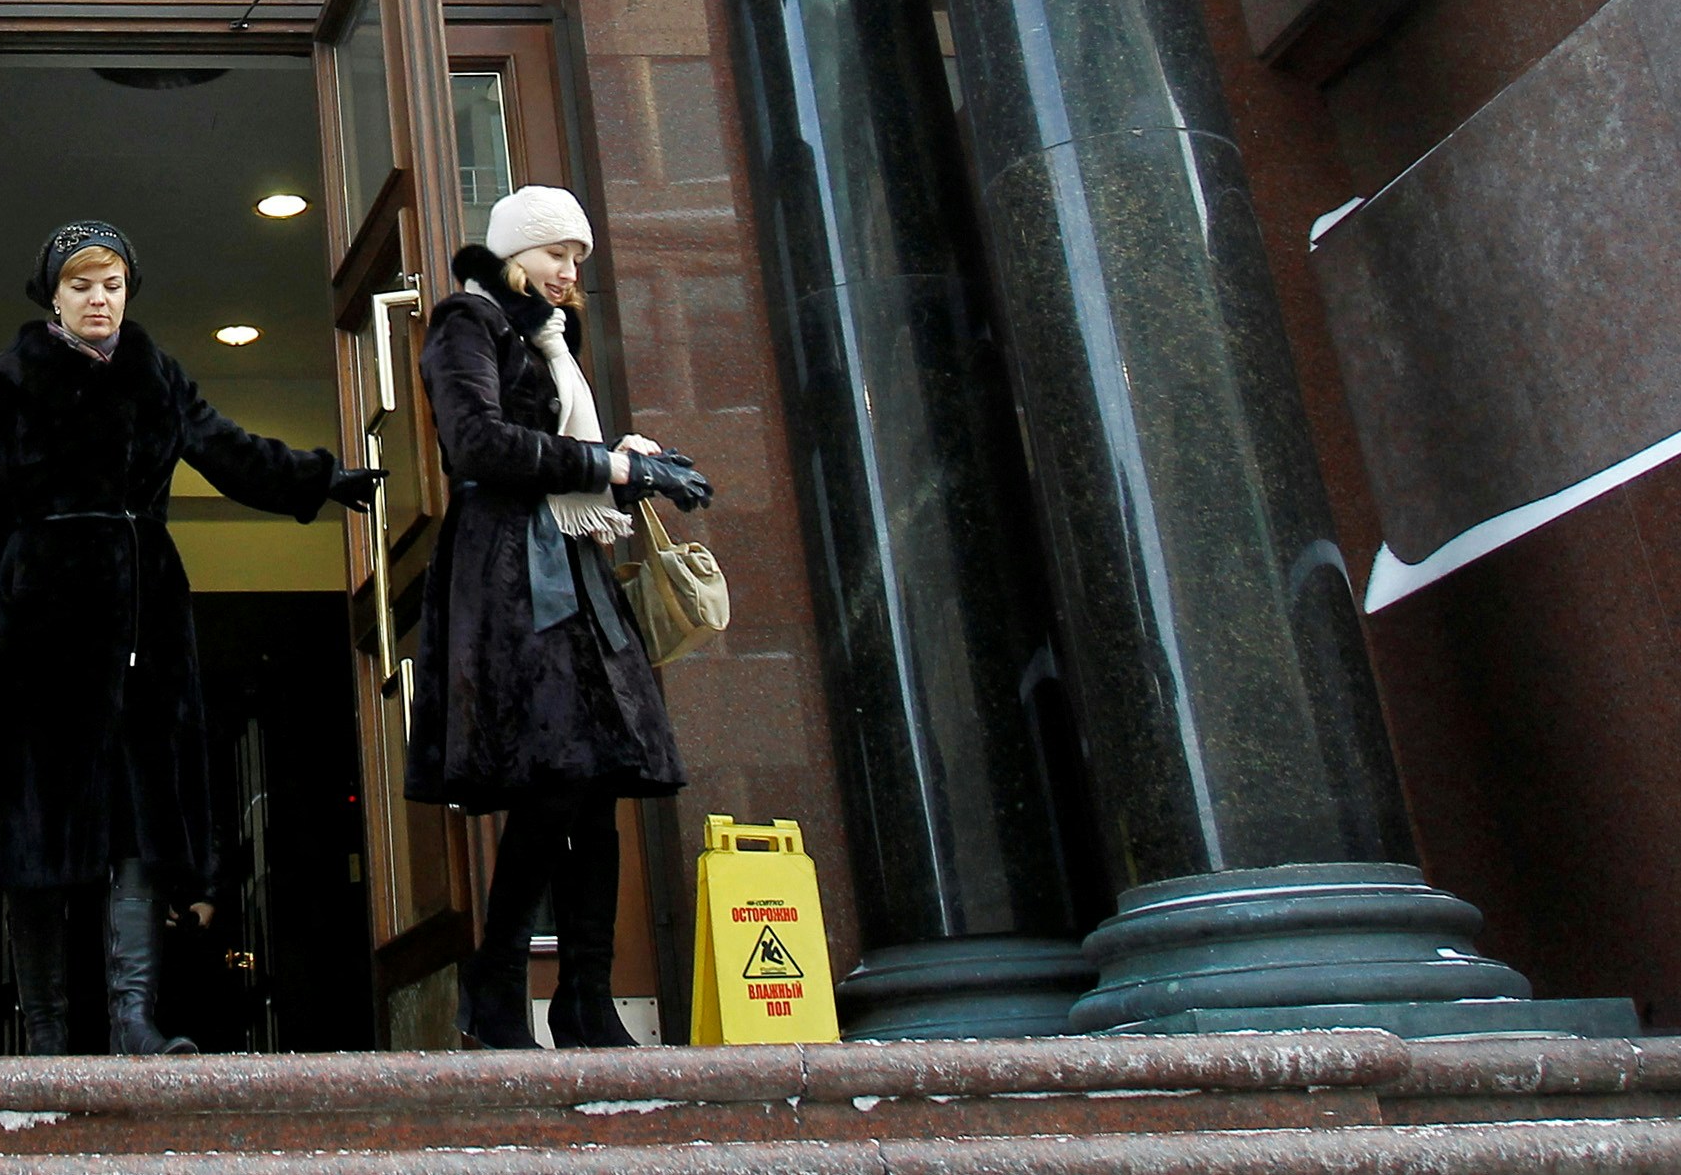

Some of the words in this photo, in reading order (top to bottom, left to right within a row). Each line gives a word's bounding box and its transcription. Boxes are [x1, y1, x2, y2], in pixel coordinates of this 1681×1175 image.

[732, 907, 798, 922] ОСТОРОЖНО
[748, 981, 803, 999] ВЛАЖНЫЙ
[767, 1001, 791, 1016] ПОЛ
